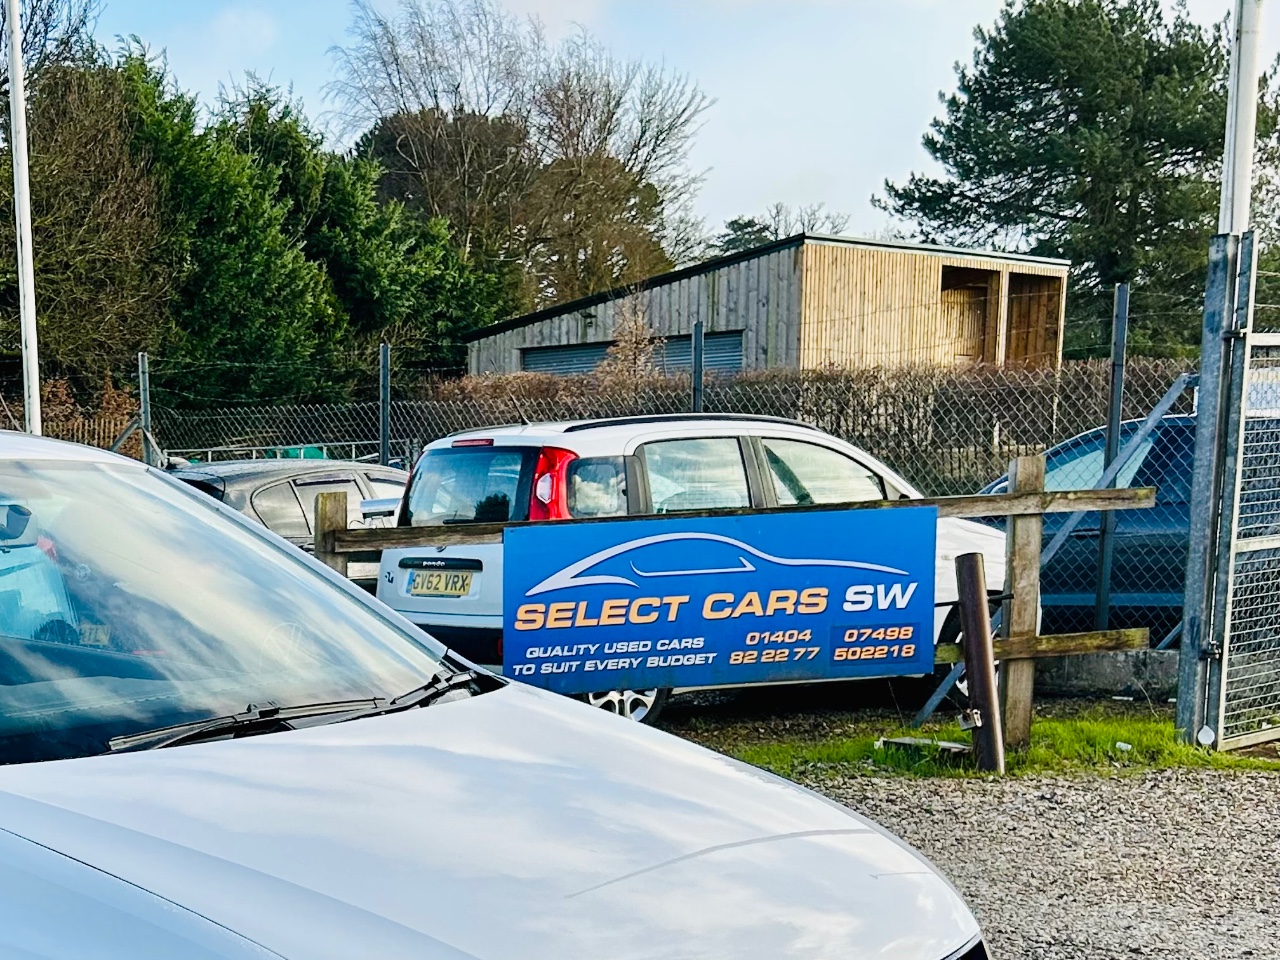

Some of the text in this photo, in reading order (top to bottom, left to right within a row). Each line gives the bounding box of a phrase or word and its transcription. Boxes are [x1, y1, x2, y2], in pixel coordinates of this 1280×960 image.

[412, 572, 442, 591] GV62
[444, 573, 469, 592] VRX
[514, 582, 918, 631] SELECT CARS SW
[745, 629, 813, 646] 01404
[843, 626, 914, 643] 07498
[525, 637, 705, 659] QUALITY USED CARS
[729, 646, 821, 665] 82 22 77
[833, 644, 916, 661] 502218
[512, 652, 718, 676] TO SUIT EVERY BUDGET
